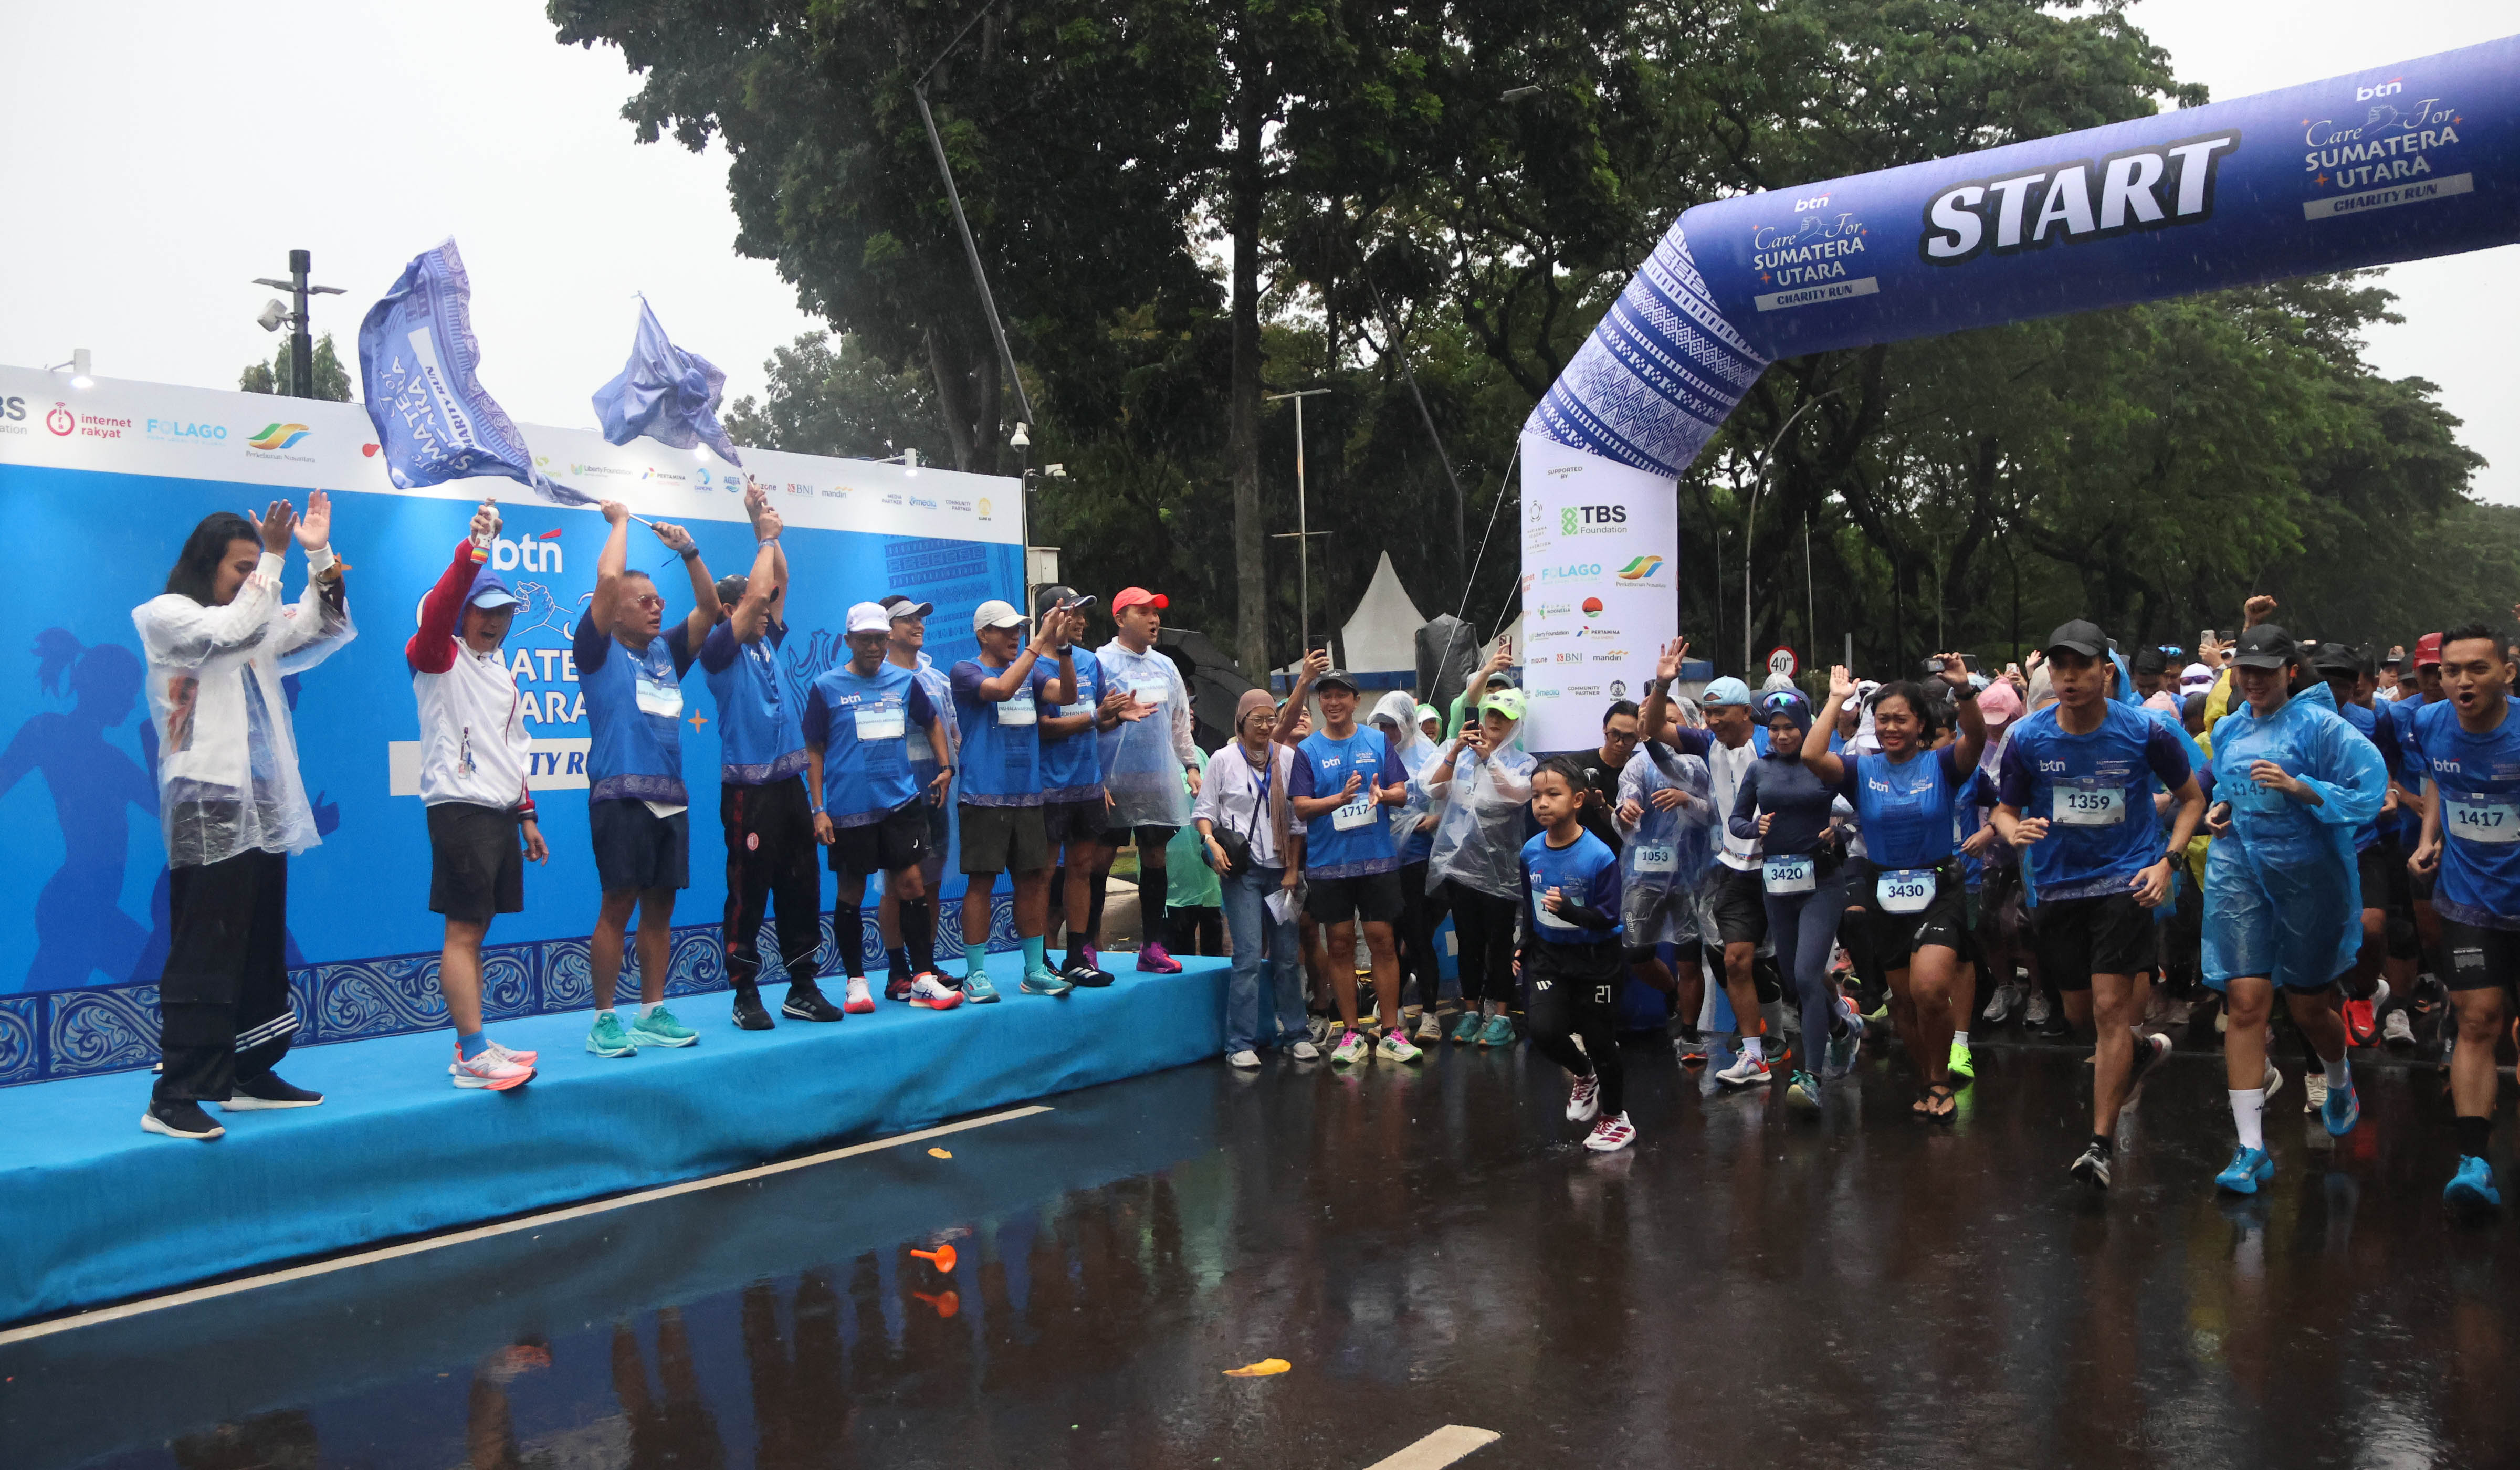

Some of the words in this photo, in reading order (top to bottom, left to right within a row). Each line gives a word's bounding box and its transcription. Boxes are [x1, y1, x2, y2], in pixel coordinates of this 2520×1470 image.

[2356, 77, 2402, 101] btn
[2306, 120, 2362, 147] Care
[2403, 98, 2455, 129] For
[2305, 126, 2460, 172] SUMATERA
[2336, 155, 2431, 188] UTARA
[1794, 192, 1831, 212] btn
[1927, 137, 2231, 257] START
[2334, 190, 2401, 211] CHARITY
[2404, 184, 2438, 200] RUN
[1755, 227, 1796, 250] Care
[1825, 213, 1862, 238] For
[1754, 237, 1865, 270] SUMATERA
[1777, 261, 1845, 286] UTARA
[1777, 289, 1826, 305] CHARITY
[1829, 285, 1852, 297] RUN
[81, 414, 132, 428] internet
[146, 418, 227, 440] FOLAGO
[81, 427, 121, 438] rakyat
[246, 450, 282, 460] Perkebunan
[284, 454, 316, 463] Nusantara
[604, 467, 633, 475] Foundation
[1547, 467, 1583, 475] SUPPORTED
[797, 484, 813, 495] BNI
[822, 489, 846, 498] mandiri
[1580, 505, 1626, 523] TBS
[492, 528, 563, 573] btn
[1542, 564, 1601, 580] FOLAGO
[1565, 653, 1582, 662] BNI
[1771, 657, 1786, 671] 40
[840, 691, 861, 705] btn
[1322, 755, 1341, 769] btn
[2040, 757, 2066, 772] btn
[2433, 757, 2461, 773] btn
[1868, 777, 1889, 793] btn
[2068, 794, 2110, 810] 1359
[1341, 804, 1368, 817] 1717
[2459, 810, 2504, 826] 1417
[1643, 850, 1668, 862] 1053
[1771, 867, 1803, 880] 3420
[1888, 884, 1924, 898] 3430
[1595, 985, 1611, 1003] 21
